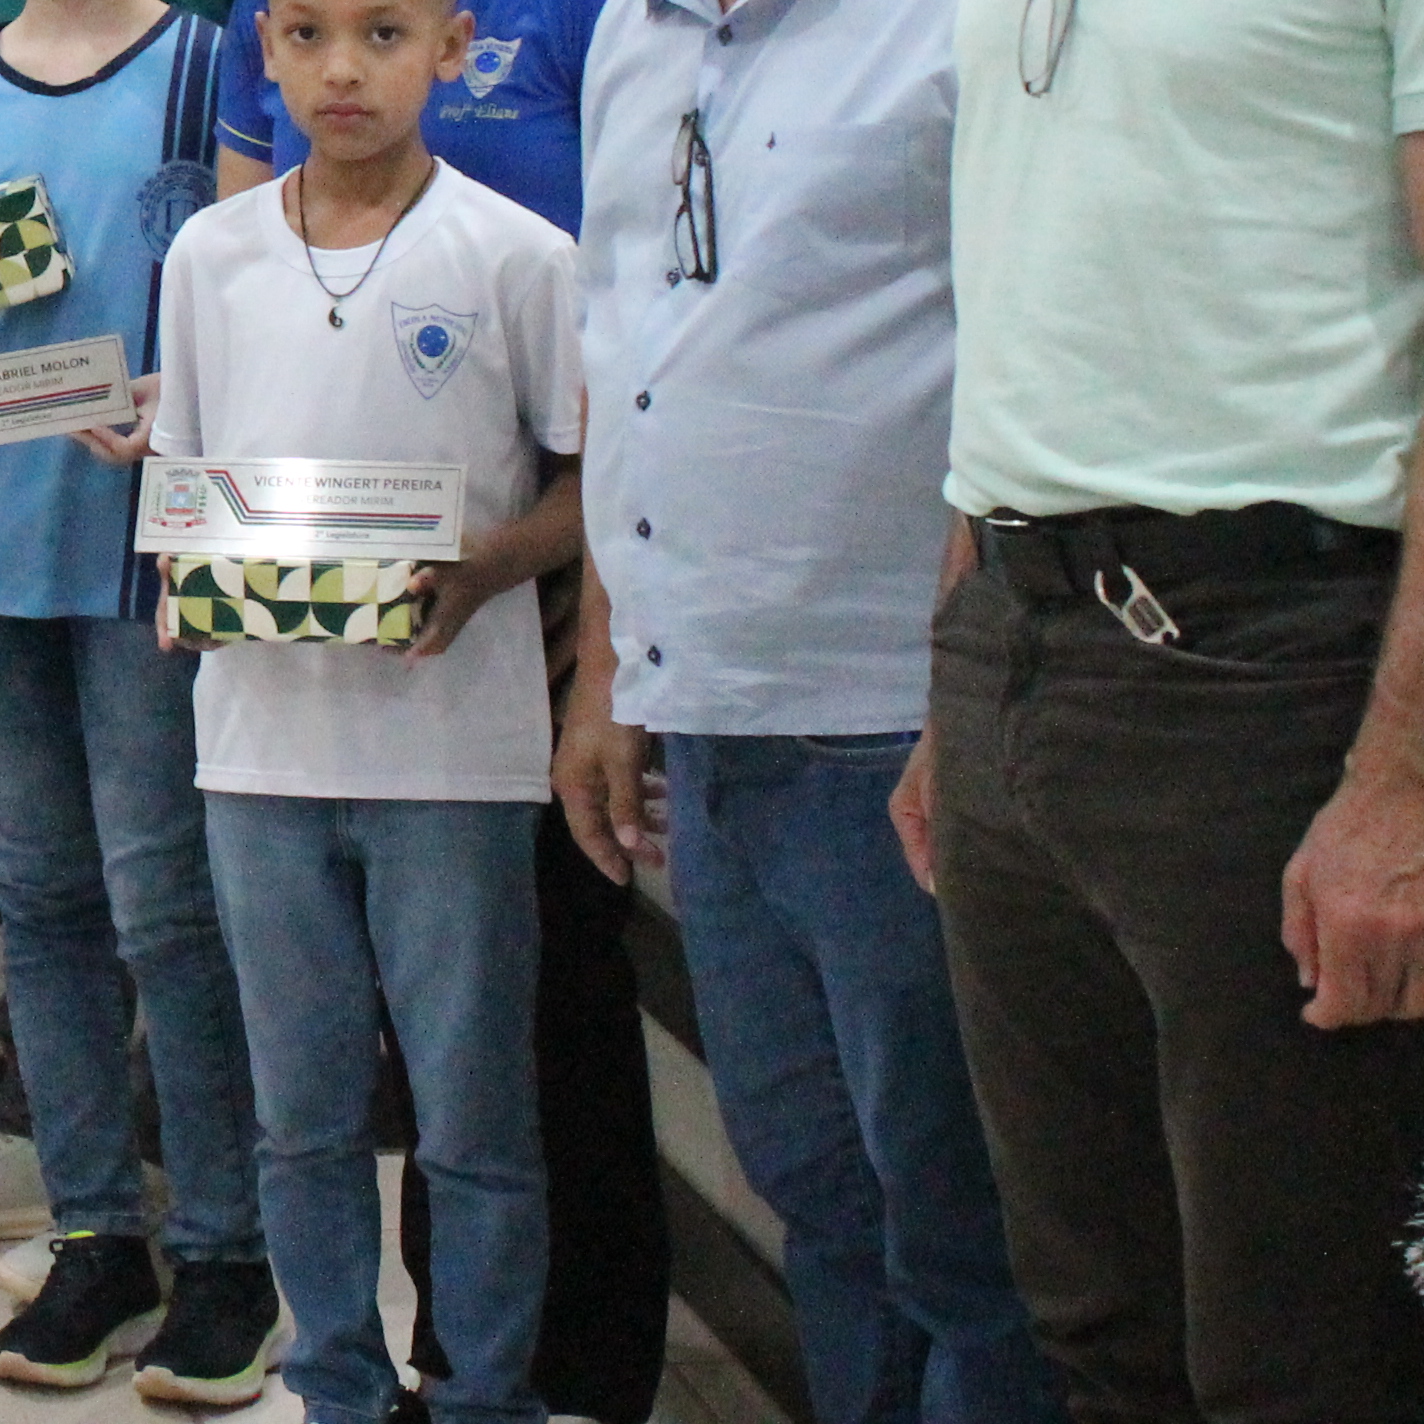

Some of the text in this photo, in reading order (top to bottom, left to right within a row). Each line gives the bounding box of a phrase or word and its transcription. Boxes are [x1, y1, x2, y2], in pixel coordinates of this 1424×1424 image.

[41, 356, 90, 373] MOLON
[315, 478, 379, 490] WINGERT
[383, 479, 443, 491] PEREIRA
[306, 495, 358, 505] EREADOR
